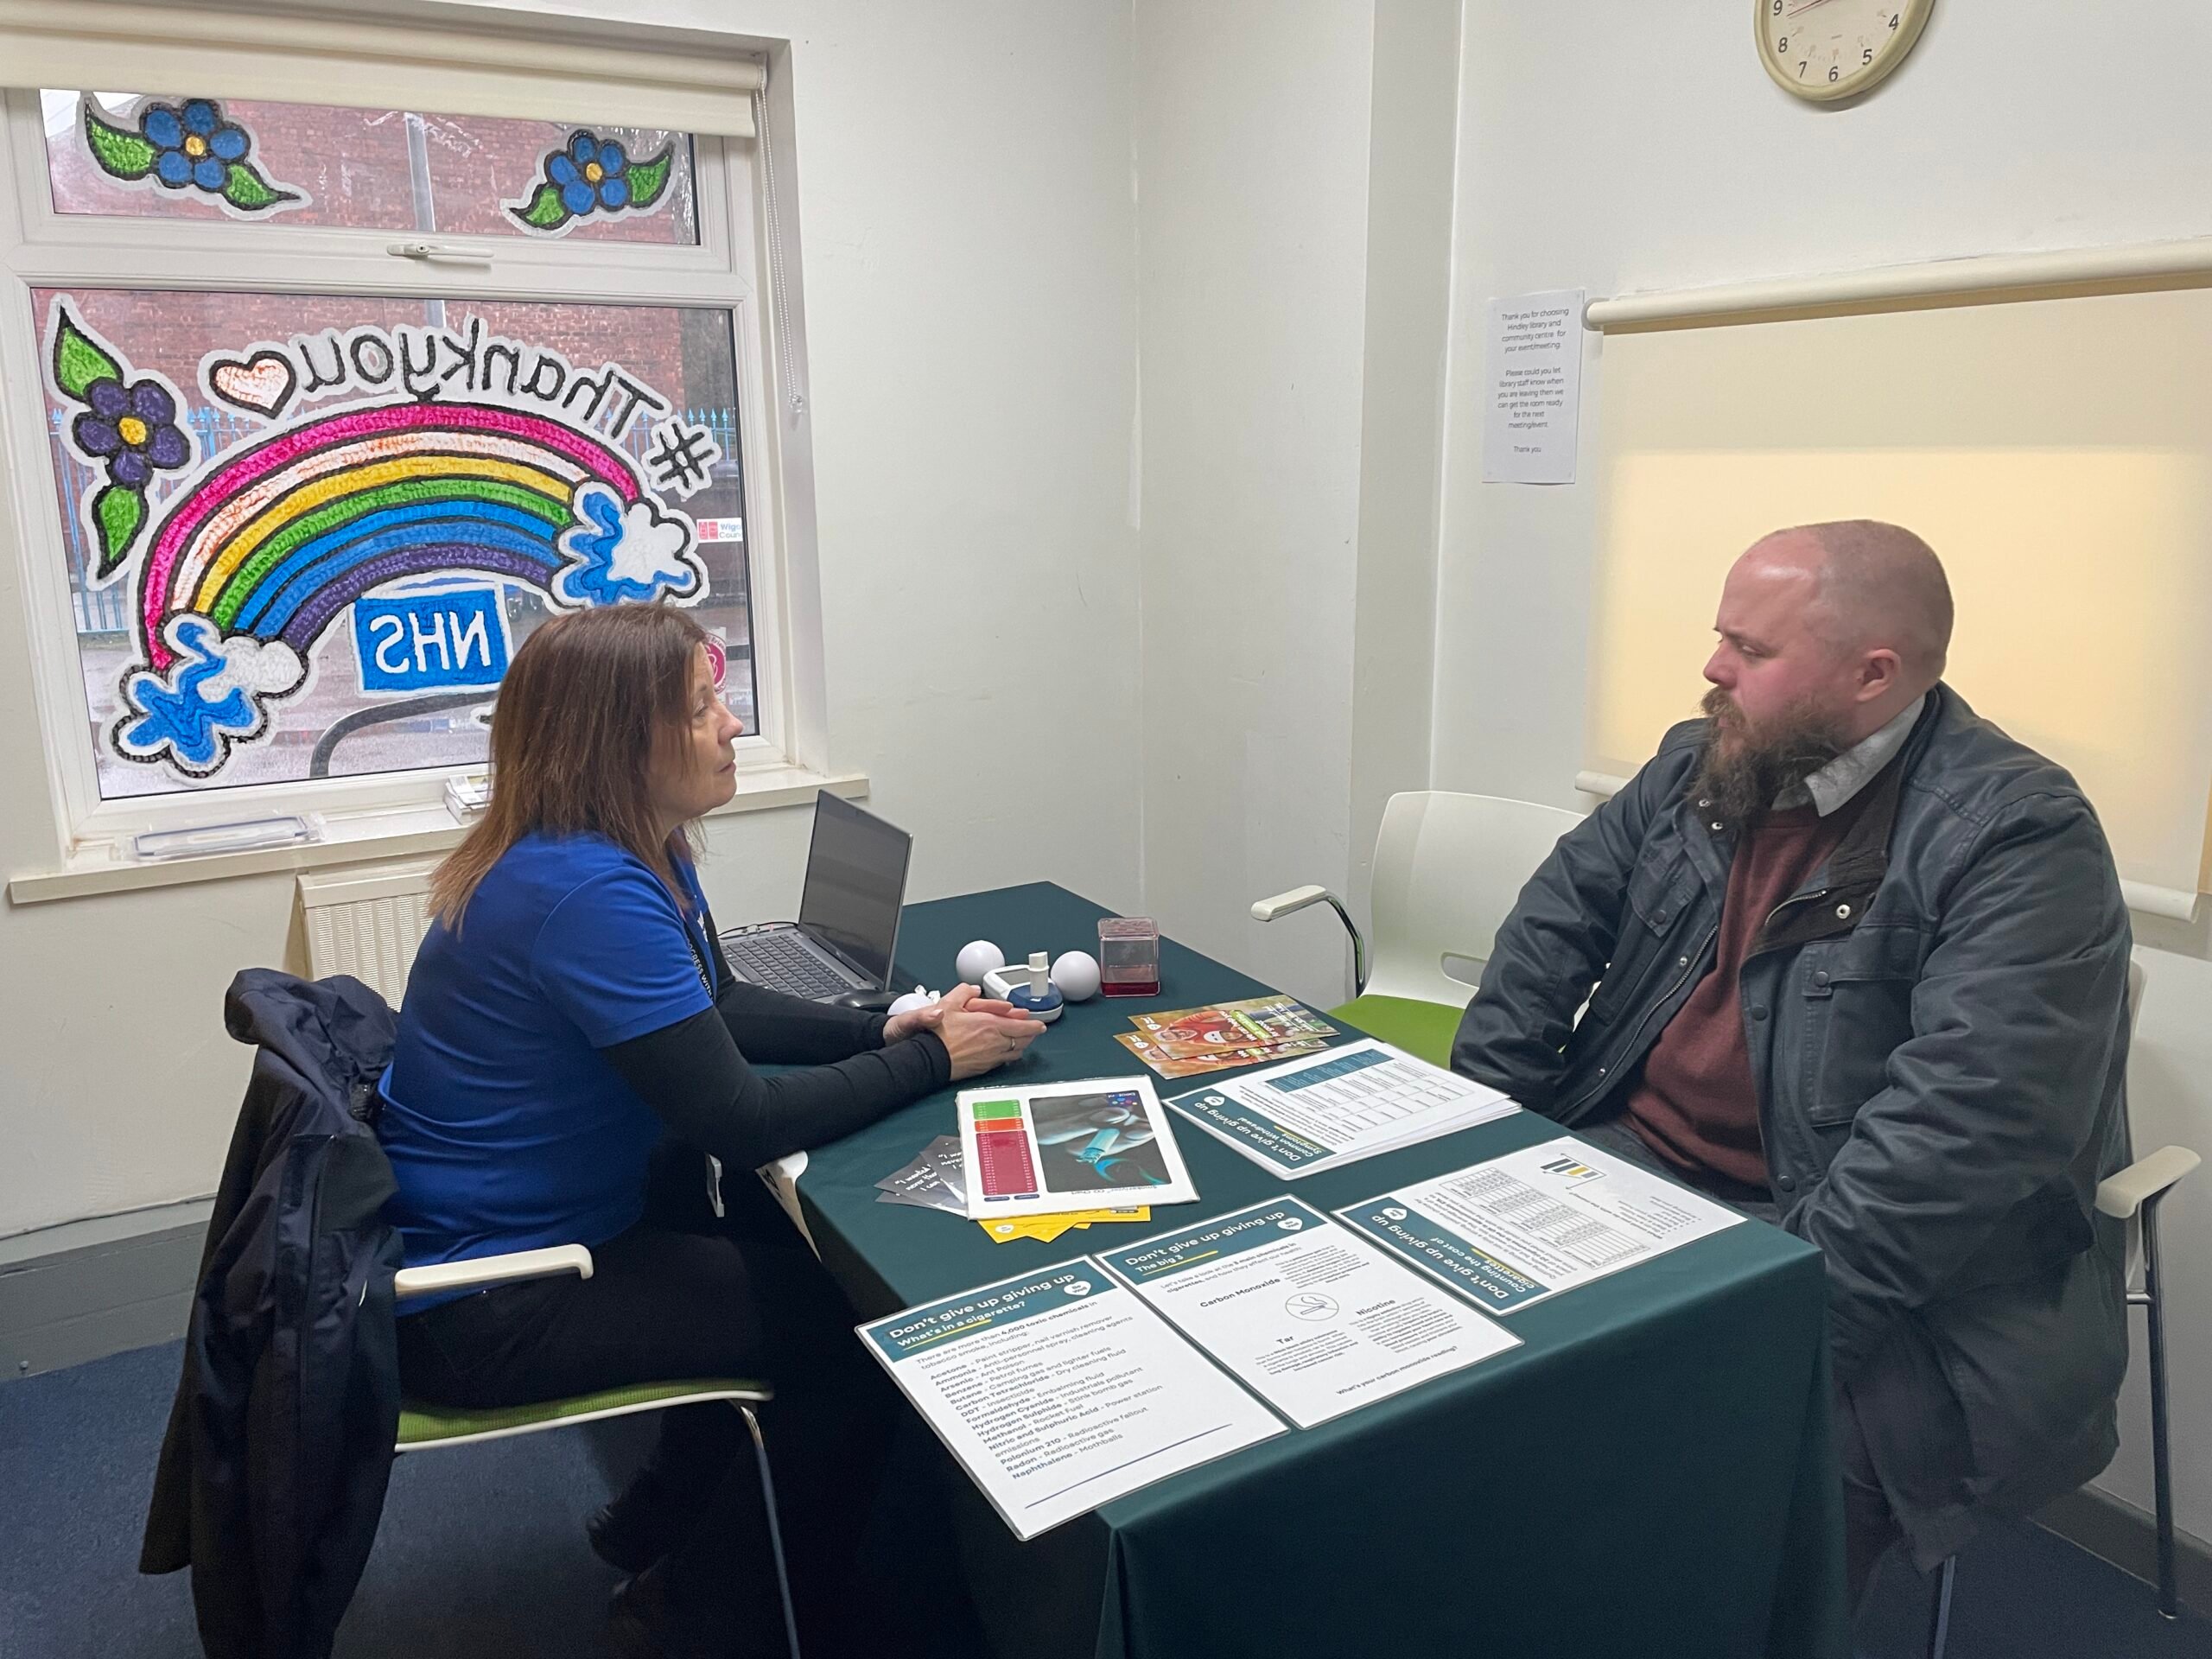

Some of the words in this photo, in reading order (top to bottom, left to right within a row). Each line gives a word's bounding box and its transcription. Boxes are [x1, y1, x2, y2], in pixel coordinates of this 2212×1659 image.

[1889, 13, 1899, 31] 4
[1777, 37, 1789, 54] 8
[1862, 48, 1873, 66] 5
[1798, 60, 1808, 79] 7
[1828, 66, 1840, 82] 6
[1540, 308, 1569, 317] choosing
[1547, 399, 1563, 408] ready
[1207, 1109, 1239, 1126] giving
[1250, 1133, 1274, 1145] give
[1271, 1144, 1301, 1161] Don't
[1371, 1215, 1389, 1225] up
[1125, 1249, 1167, 1265] Don't
[1168, 1239, 1198, 1253] give
[1199, 1232, 1220, 1241] up
[1222, 1218, 1266, 1236] giving
[1388, 1224, 1428, 1248] giving
[1425, 1248, 1444, 1258] up
[1442, 1243, 1465, 1256] cost
[1464, 1255, 1481, 1266] the
[1135, 1263, 1157, 1272] The
[1156, 1257, 1176, 1266] big
[1443, 1258, 1474, 1275] give
[1471, 1274, 1509, 1299] Don't
[1480, 1265, 1526, 1292] Counting
[1199, 1294, 1236, 1307] Carbon
[1235, 1279, 1281, 1295] Monoxide
[889, 1317, 938, 1338] Don't
[939, 1306, 974, 1321] give
[976, 1298, 999, 1308] up
[1001, 1281, 1052, 1302] giving
[1053, 1274, 1074, 1284] up
[1356, 1300, 1395, 1315] Nicotine
[897, 1328, 942, 1346] What's
[966, 1300, 1025, 1323] cigarette?
[916, 1353, 941, 1363] There
[957, 1339, 980, 1349] more
[1001, 1325, 1025, 1335] 4,000
[1048, 1304, 1089, 1319] chemicals
[931, 1364, 967, 1380] Acetone
[940, 1377, 974, 1392] Arsenic
[995, 1360, 1025, 1371] Poison
[944, 1382, 983, 1398] Benzene
[988, 1370, 1015, 1382] Petrol
[1015, 1362, 1043, 1373] fumes
[950, 1390, 982, 1404] Butane
[988, 1374, 1029, 1389] Camping
[1029, 1369, 1046, 1377] gas
[1062, 1354, 1089, 1365] lighter
[1090, 1347, 1111, 1356] fuels
[955, 1395, 989, 1410] Carbon
[989, 1375, 1050, 1397] Tetrachloride
[1071, 1356, 1108, 1370] cleaning
[1107, 1349, 1126, 1357] fluid
[960, 1407, 979, 1417] DDT
[987, 1388, 1035, 1407] Insecticide
[966, 1397, 1030, 1423] Formaldehyde
[1036, 1379, 1085, 1397] Embalming
[1084, 1371, 1104, 1381] fluid
[971, 1411, 1016, 1430] Hydrogen
[1017, 1398, 1054, 1413] Cyanide
[1059, 1381, 1105, 1398] Industrials
[1105, 1367, 1143, 1383] pollutant
[976, 1417, 1022, 1437] Hydrogen
[1022, 1403, 1062, 1419] Sulphide
[1068, 1393, 1091, 1403] Stink
[1090, 1384, 1116, 1395] bomb
[1117, 1379, 1133, 1388] gas
[982, 1423, 1027, 1444] Methanol
[1033, 1410, 1065, 1424] Rocket
[1065, 1403, 1084, 1414] Fuel
[988, 1438, 1015, 1451] Nitric
[1016, 1429, 1034, 1440] and
[1034, 1414, 1077, 1433] Sulphuric
[1079, 1407, 1099, 1417] Acid
[1104, 1395, 1131, 1408] Power
[1133, 1385, 1163, 1398] station
[995, 1437, 1040, 1458] emissions
[1000, 1445, 1045, 1465] Polonium
[1045, 1438, 1061, 1447] 210
[1067, 1418, 1119, 1439] Radioactive
[1119, 1407, 1148, 1420] fallout
[1006, 1457, 1037, 1471] Radon
[1043, 1434, 1096, 1457] Radioactive
[1097, 1428, 1114, 1438] gas
[1012, 1453, 1072, 1479] Naphthalene
[1078, 1433, 1123, 1452] Mothballs
